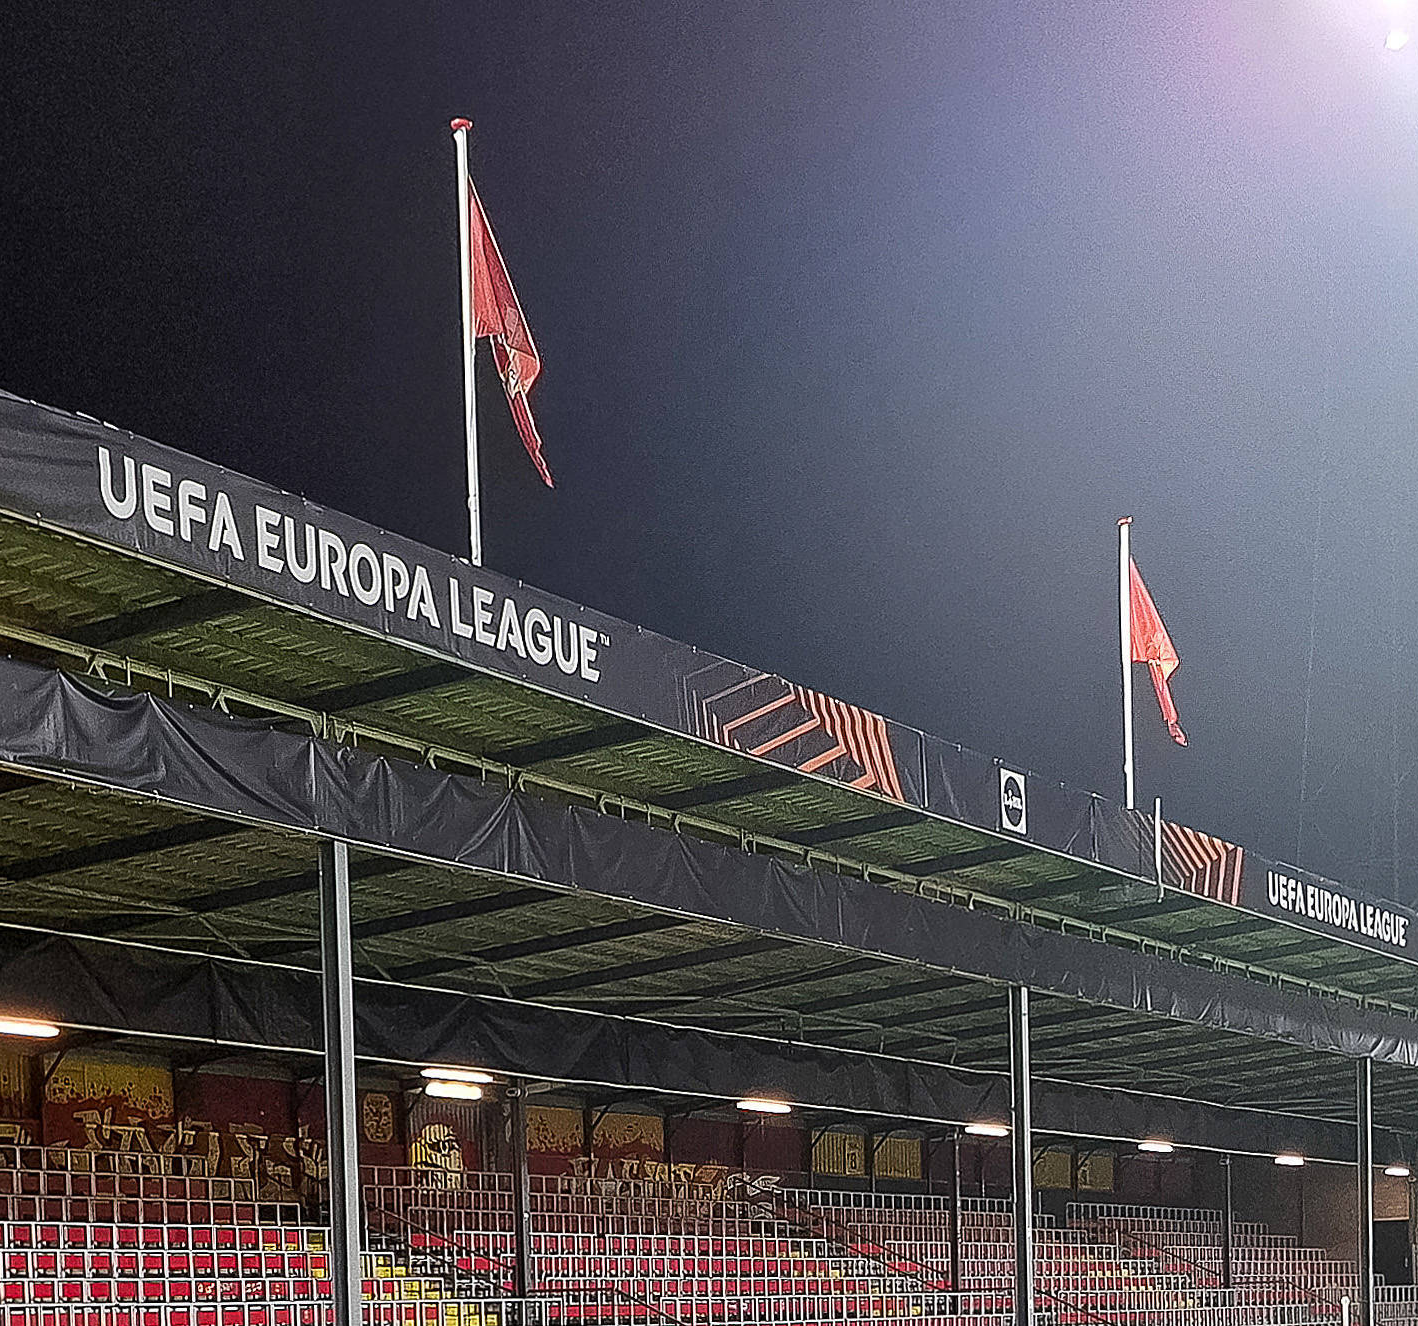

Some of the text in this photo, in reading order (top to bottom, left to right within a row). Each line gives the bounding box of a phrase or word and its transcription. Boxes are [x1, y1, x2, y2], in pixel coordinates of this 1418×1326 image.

[98, 446, 244, 561] UEFA
[255, 505, 441, 629] EUROPA
[1267, 871, 1306, 915] UEFA
[1306, 884, 1359, 932] EUROPA
